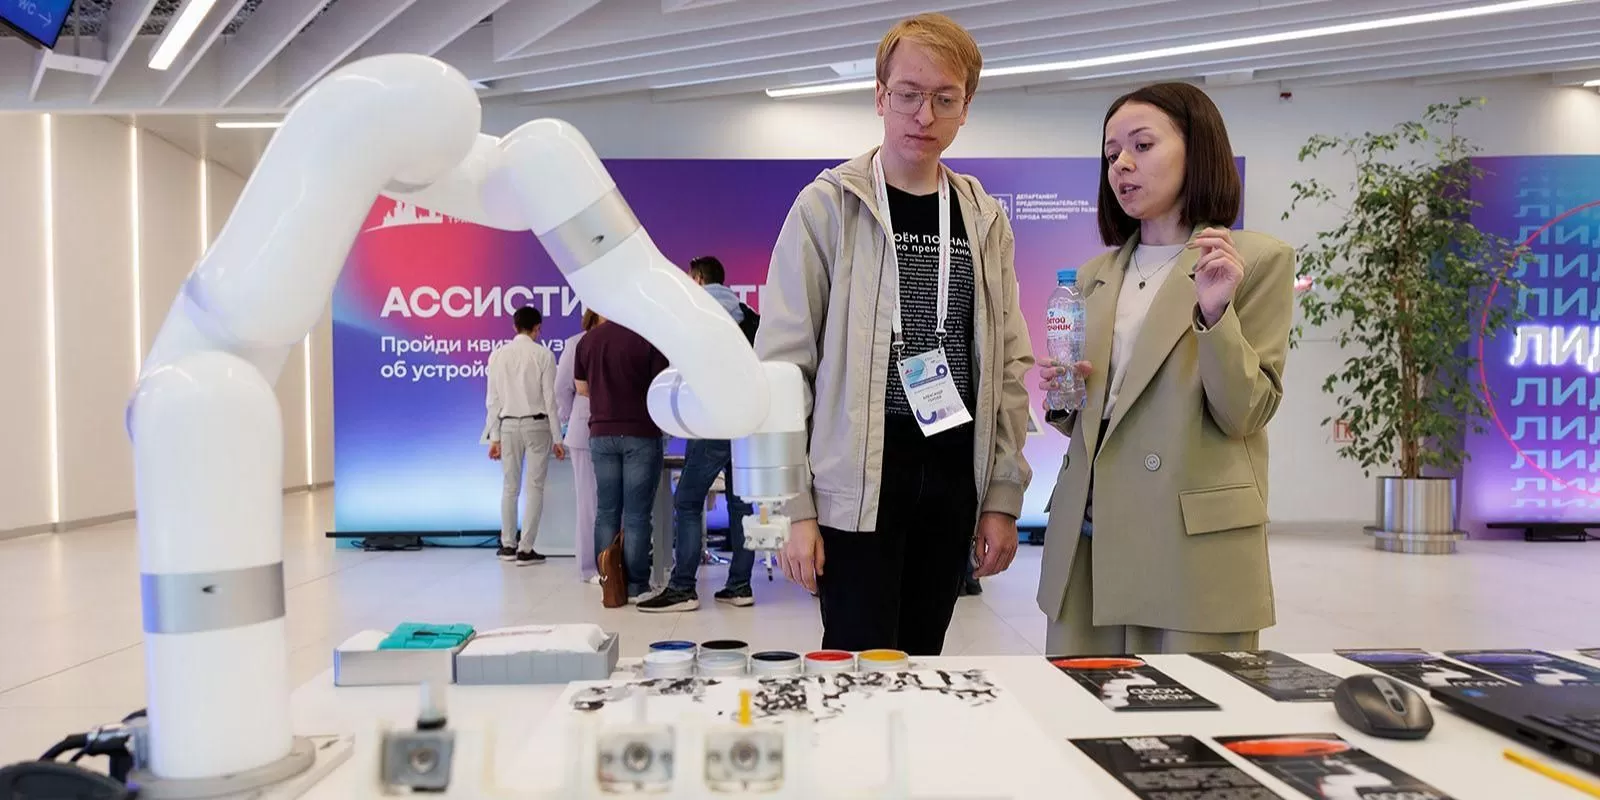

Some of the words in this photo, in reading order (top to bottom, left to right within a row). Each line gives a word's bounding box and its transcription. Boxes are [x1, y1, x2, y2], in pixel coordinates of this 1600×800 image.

[894, 231, 919, 243] ОЁМ
[380, 286, 586, 318] АССИСТИ
[381, 335, 461, 356] Пройди
[467, 339, 513, 352] кви
[381, 361, 408, 378] об
